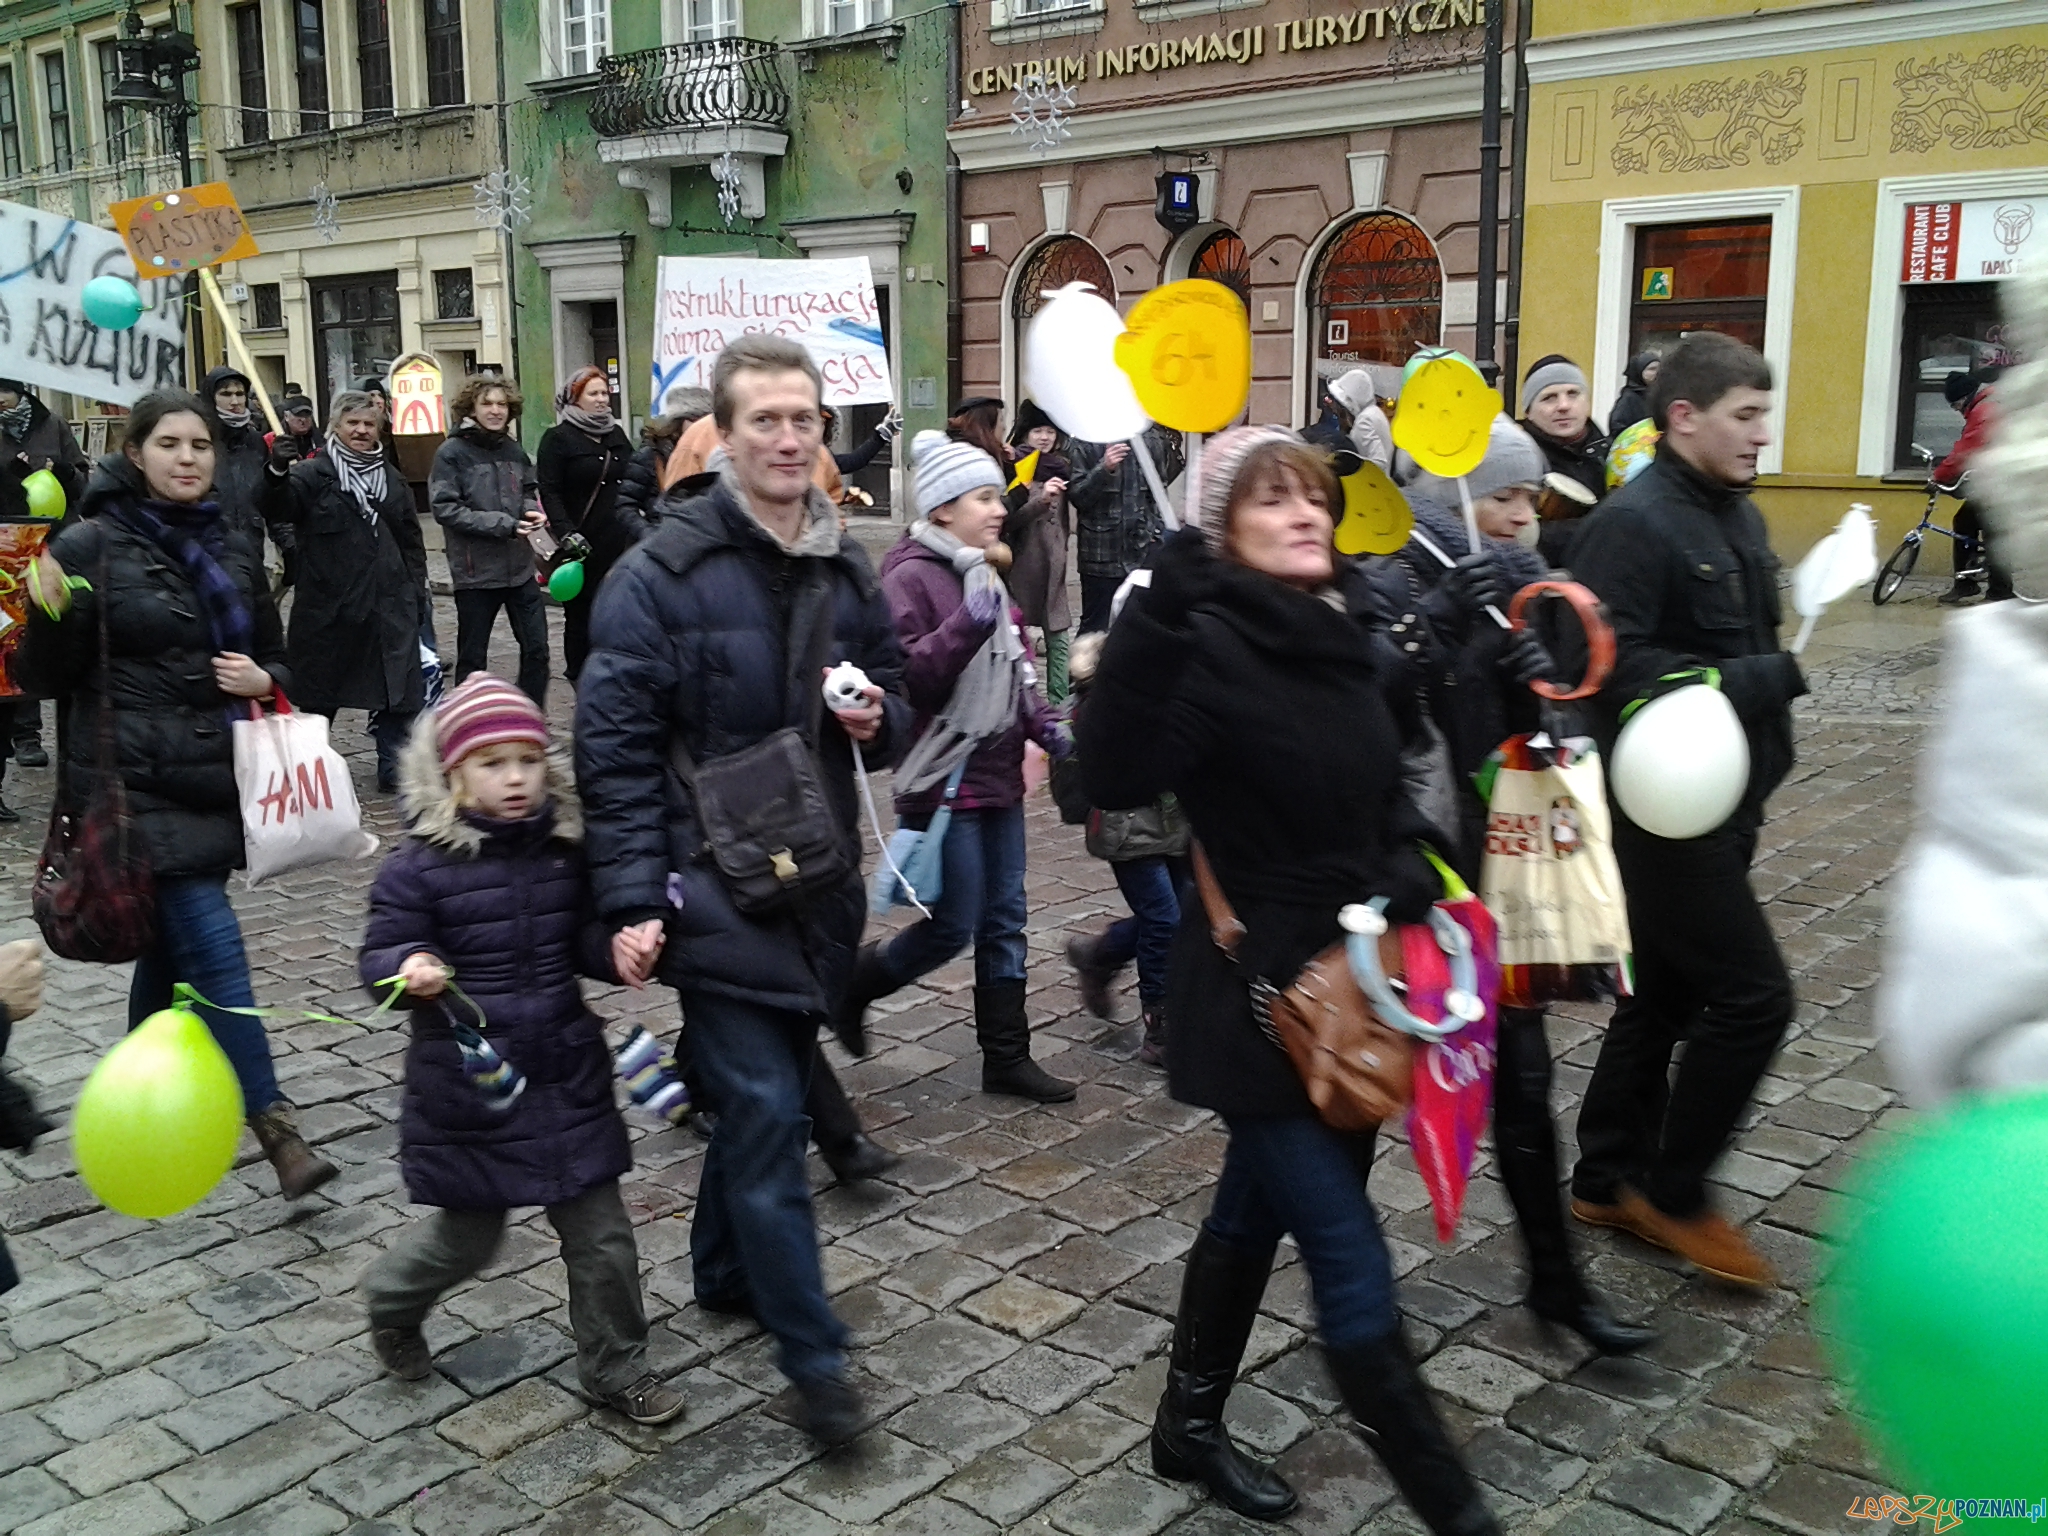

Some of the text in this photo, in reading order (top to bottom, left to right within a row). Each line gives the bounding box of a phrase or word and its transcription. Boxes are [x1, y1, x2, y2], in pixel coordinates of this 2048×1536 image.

[967, 54, 1087, 96] CENTRUM
[1096, 25, 1263, 78] INFORMACJI
[28, 219, 78, 285] W
[129, 208, 242, 255] PLASTYKA
[1910, 205, 1931, 282] RESTAURANT
[1930, 203, 1951, 281] CAFE CLUB
[1981, 259, 2013, 275] TAPAS
[1327, 348, 1359, 361] Tourist
[257, 756, 333, 827] H&M
